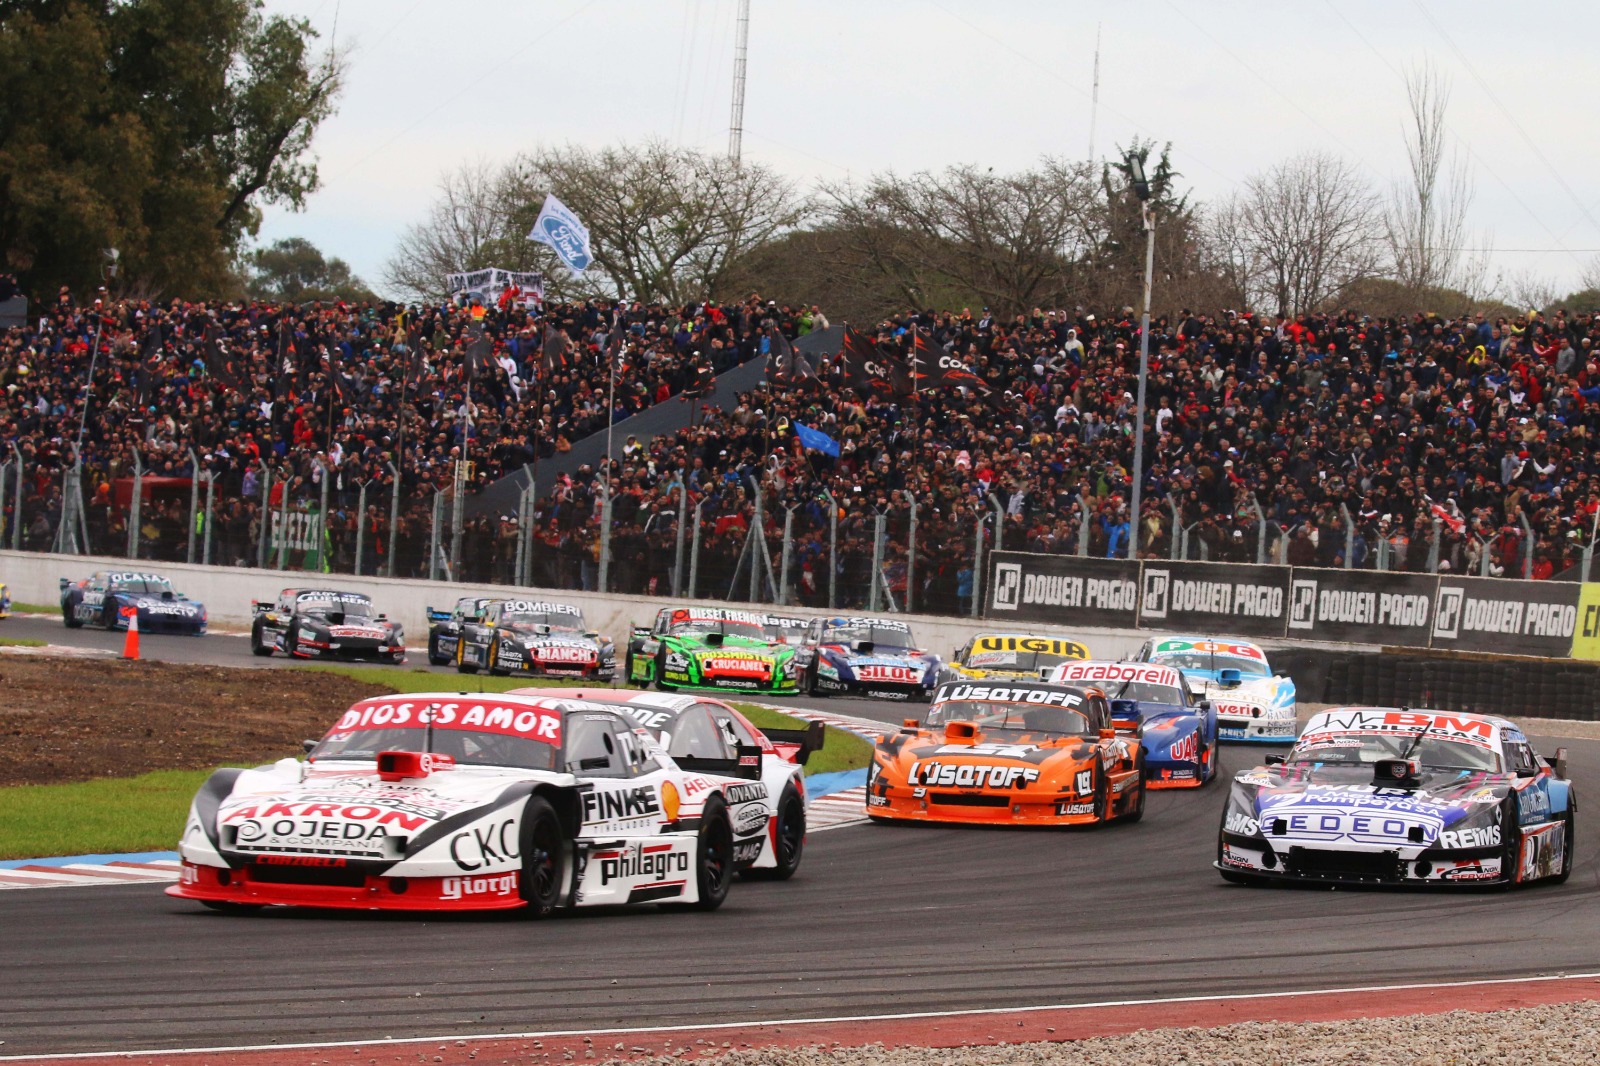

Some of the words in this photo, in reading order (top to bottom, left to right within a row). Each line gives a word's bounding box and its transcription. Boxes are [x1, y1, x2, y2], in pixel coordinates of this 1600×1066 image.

[1024, 574, 1083, 607] DOWEN
[1172, 580, 1232, 614] DOWEN
[1319, 590, 1376, 624] DOWEN
[504, 601, 580, 617] BOMBIERI
[1463, 598, 1523, 634] DOWEN
[1060, 664, 1177, 687] Taraborelli
[338, 703, 414, 730] DIOS
[418, 703, 459, 724] ES
[461, 705, 561, 738] AMOR
[1384, 712, 1492, 738] BM
[222, 803, 428, 831] AKRON
[582, 785, 660, 822] FINKE
[273, 819, 388, 841] OJEDA
[601, 842, 689, 886] philagro
